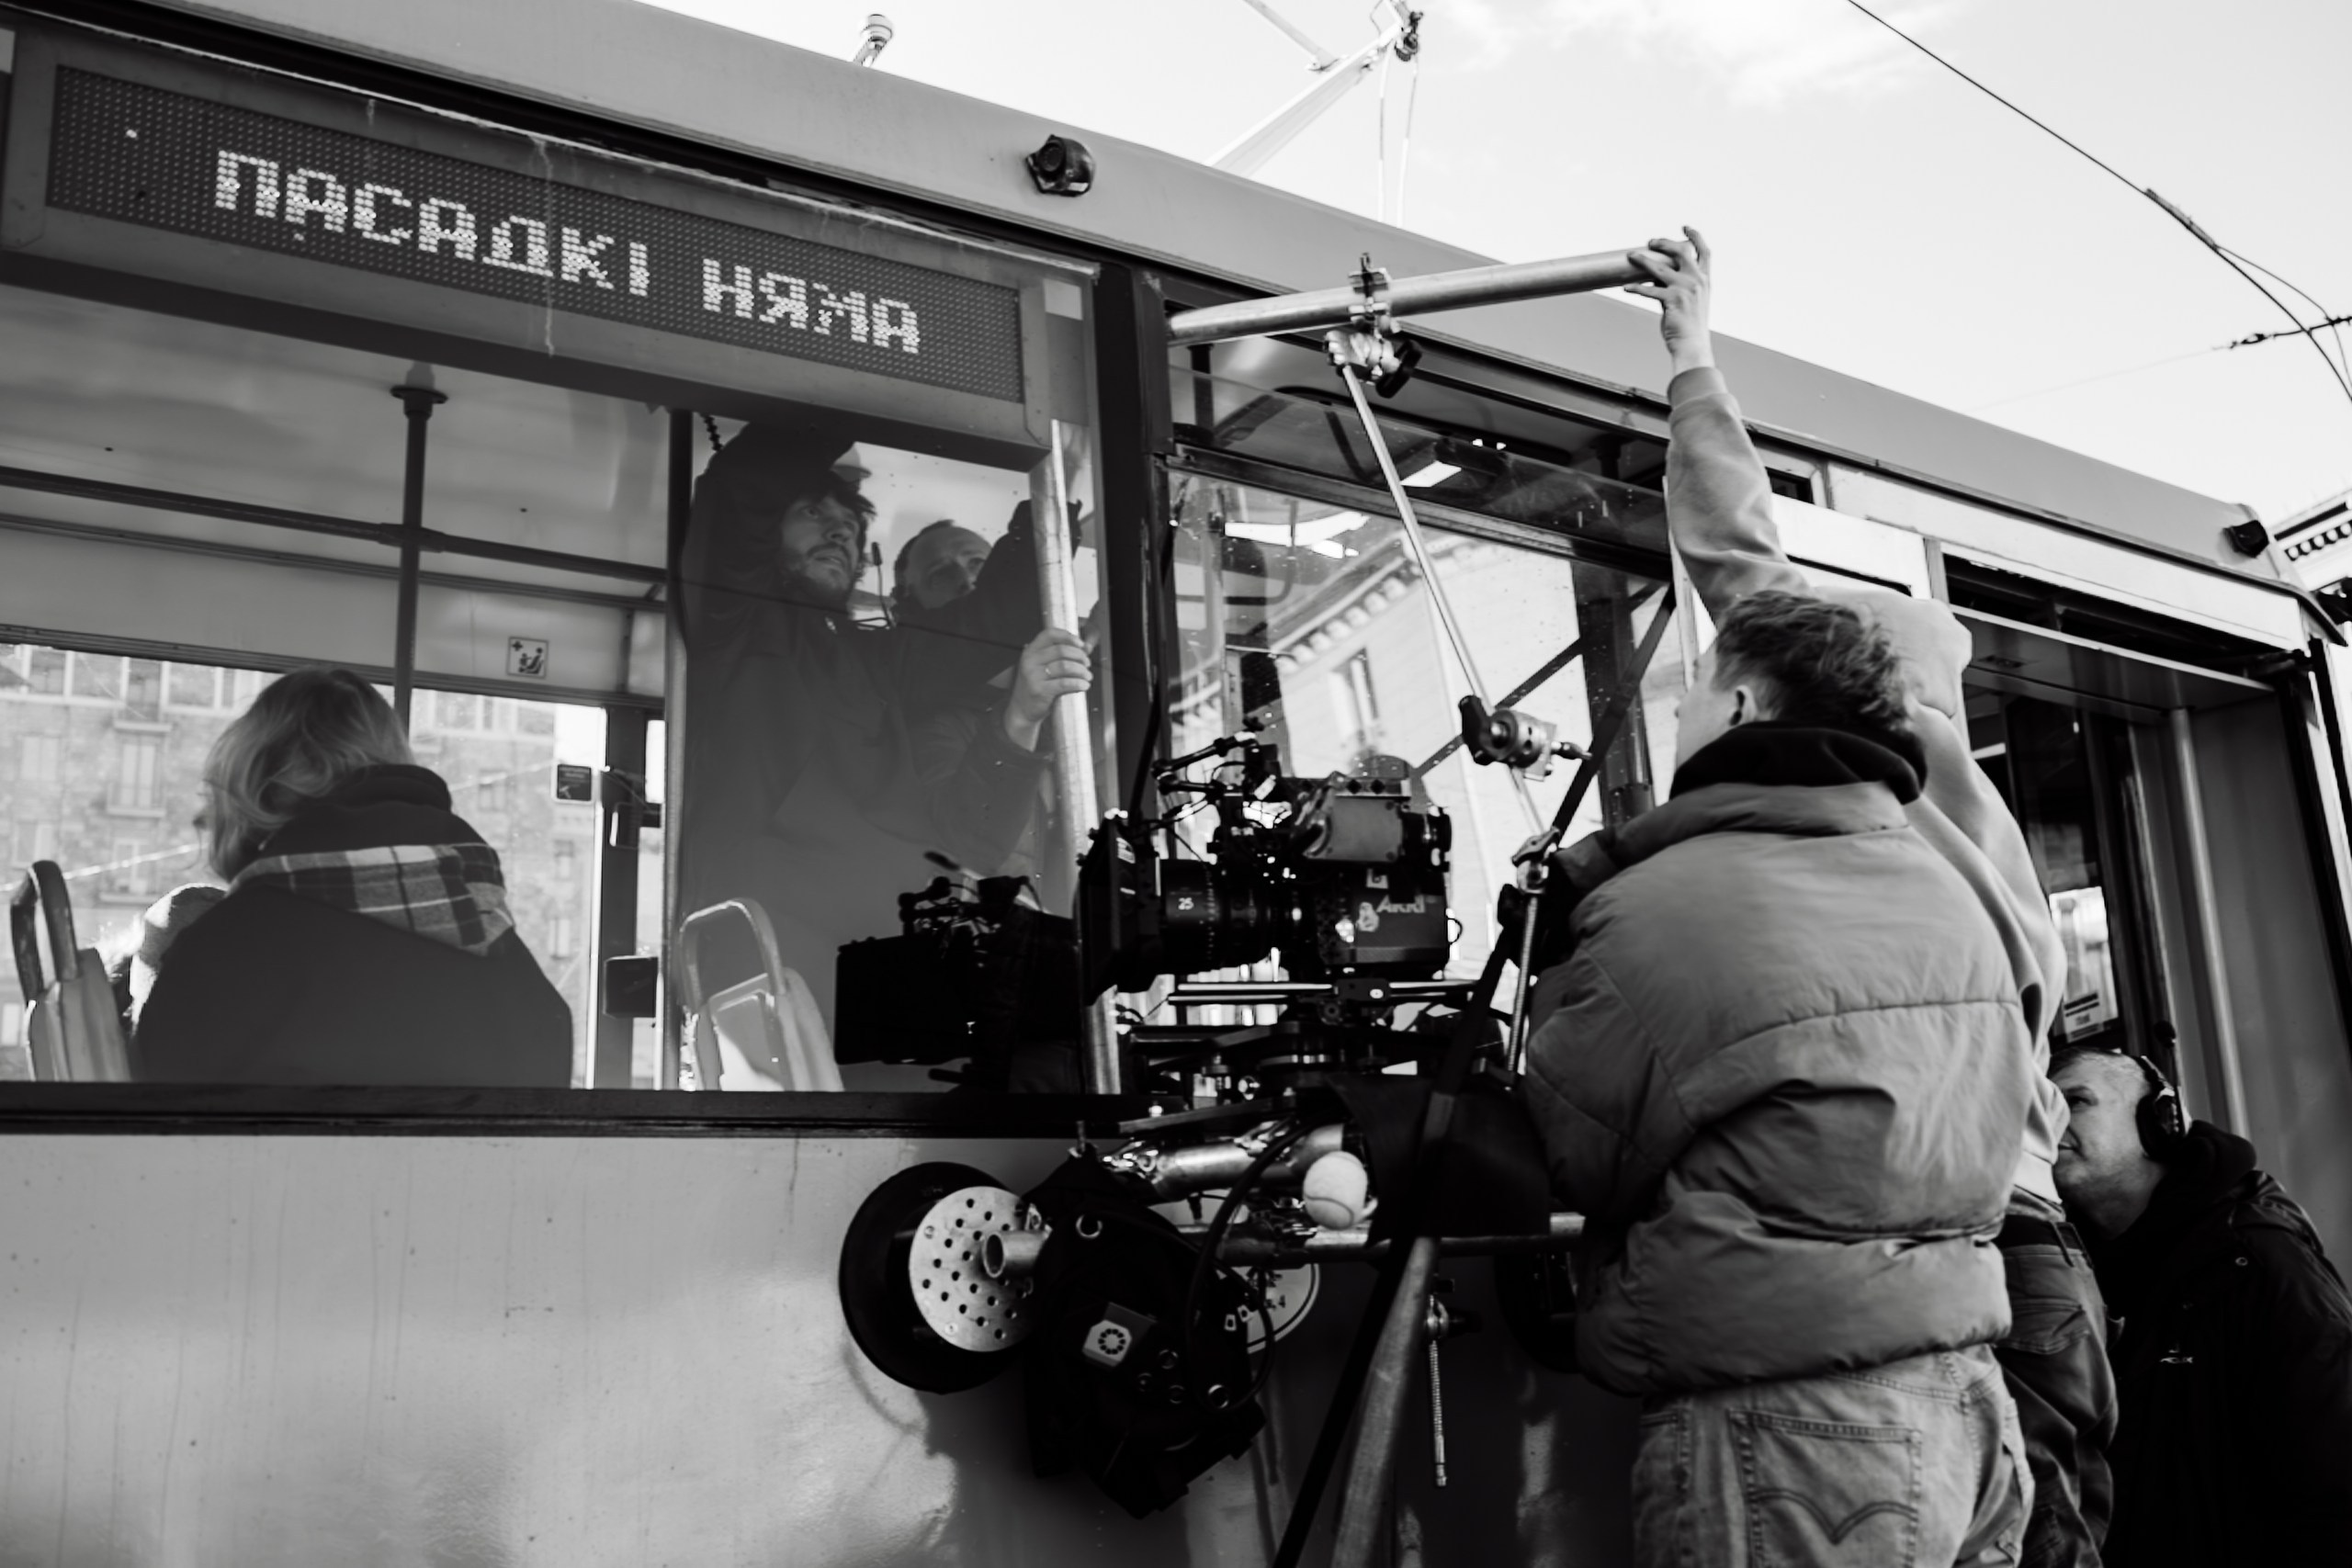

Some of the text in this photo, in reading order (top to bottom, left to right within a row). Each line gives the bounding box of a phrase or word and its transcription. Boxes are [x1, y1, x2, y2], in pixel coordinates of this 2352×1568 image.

[214, 150, 921, 355] ПАСАДКІ НЯМА
[1177, 897, 1194, 911] 25
